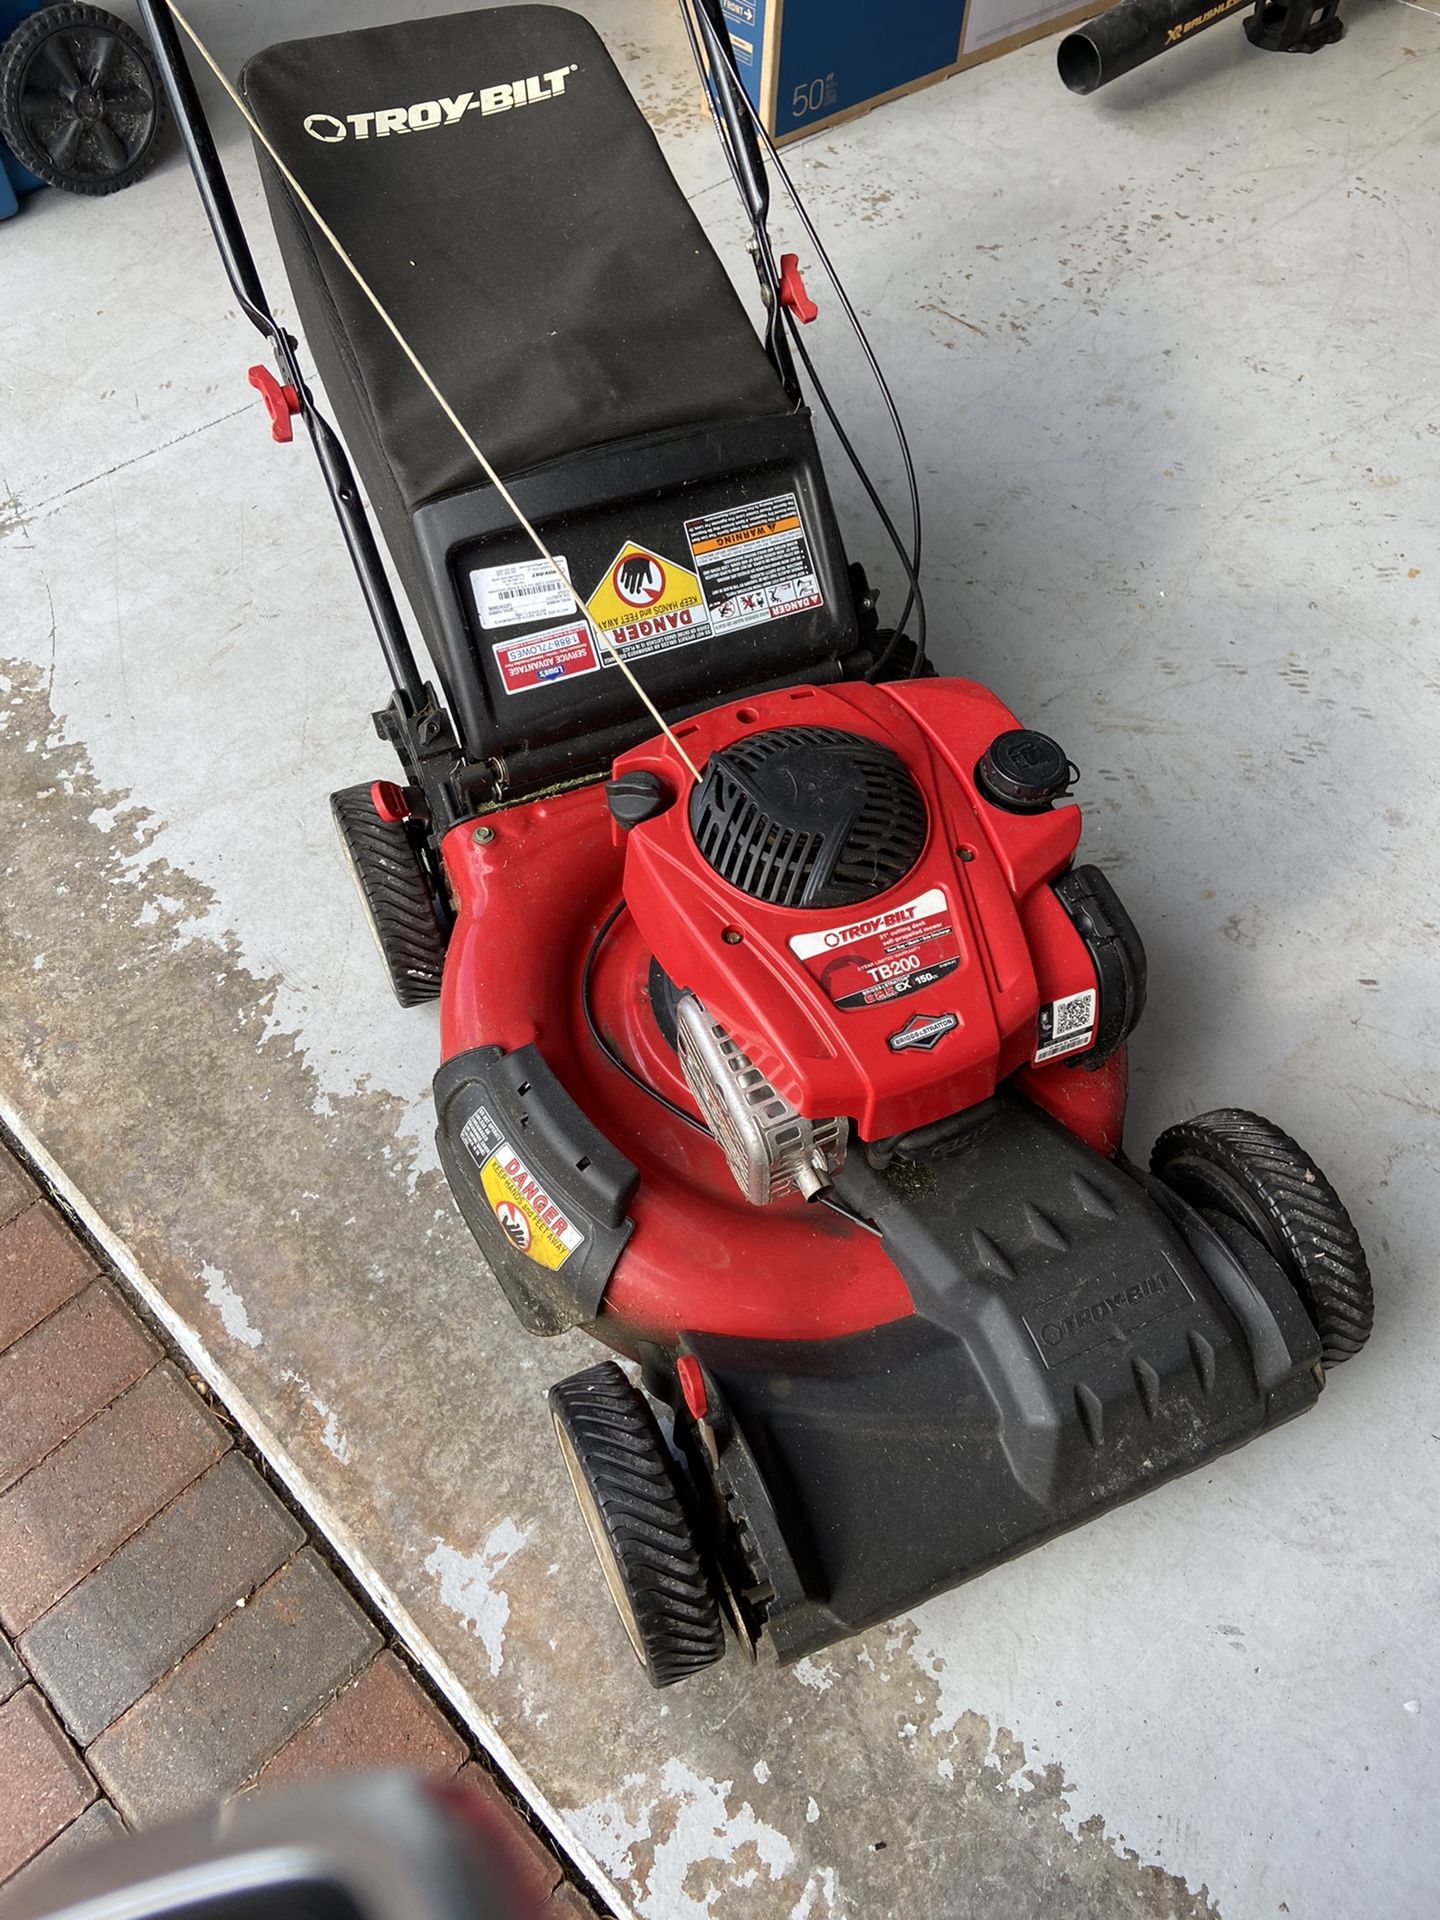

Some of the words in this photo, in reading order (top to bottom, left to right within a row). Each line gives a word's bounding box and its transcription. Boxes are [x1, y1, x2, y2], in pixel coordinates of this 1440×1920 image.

[346, 65, 570, 140] TROY-BILT
[716, 526, 765, 546] WARNING
[652, 599, 678, 615] HANDS
[678, 593, 698, 607] KEEP
[771, 597, 810, 616] DANGER
[619, 611, 639, 625] FEET
[638, 607, 653, 619] and
[612, 608, 692, 644] DANGER
[509, 635, 577, 660] 1-888-77LOWES
[677, 633, 695, 642] OPERATE
[554, 647, 587, 663] SERVICE
[507, 656, 554, 676] ADVANTAGE
[839, 907, 915, 942] TROY-BILT
[883, 929, 923, 946] self-propelled
[923, 923, 942, 934] mower
[890, 925, 911, 937] cutting
[912, 920, 926, 929] deck
[867, 955, 920, 983] TB200
[505, 1158, 568, 1237] DANGER
[491, 1161, 507, 1184] KEEP
[505, 1177, 525, 1205] HANDS
[522, 1204, 534, 1218] and
[532, 1213, 549, 1234] FEET
[547, 1231, 568, 1256] AWAY
